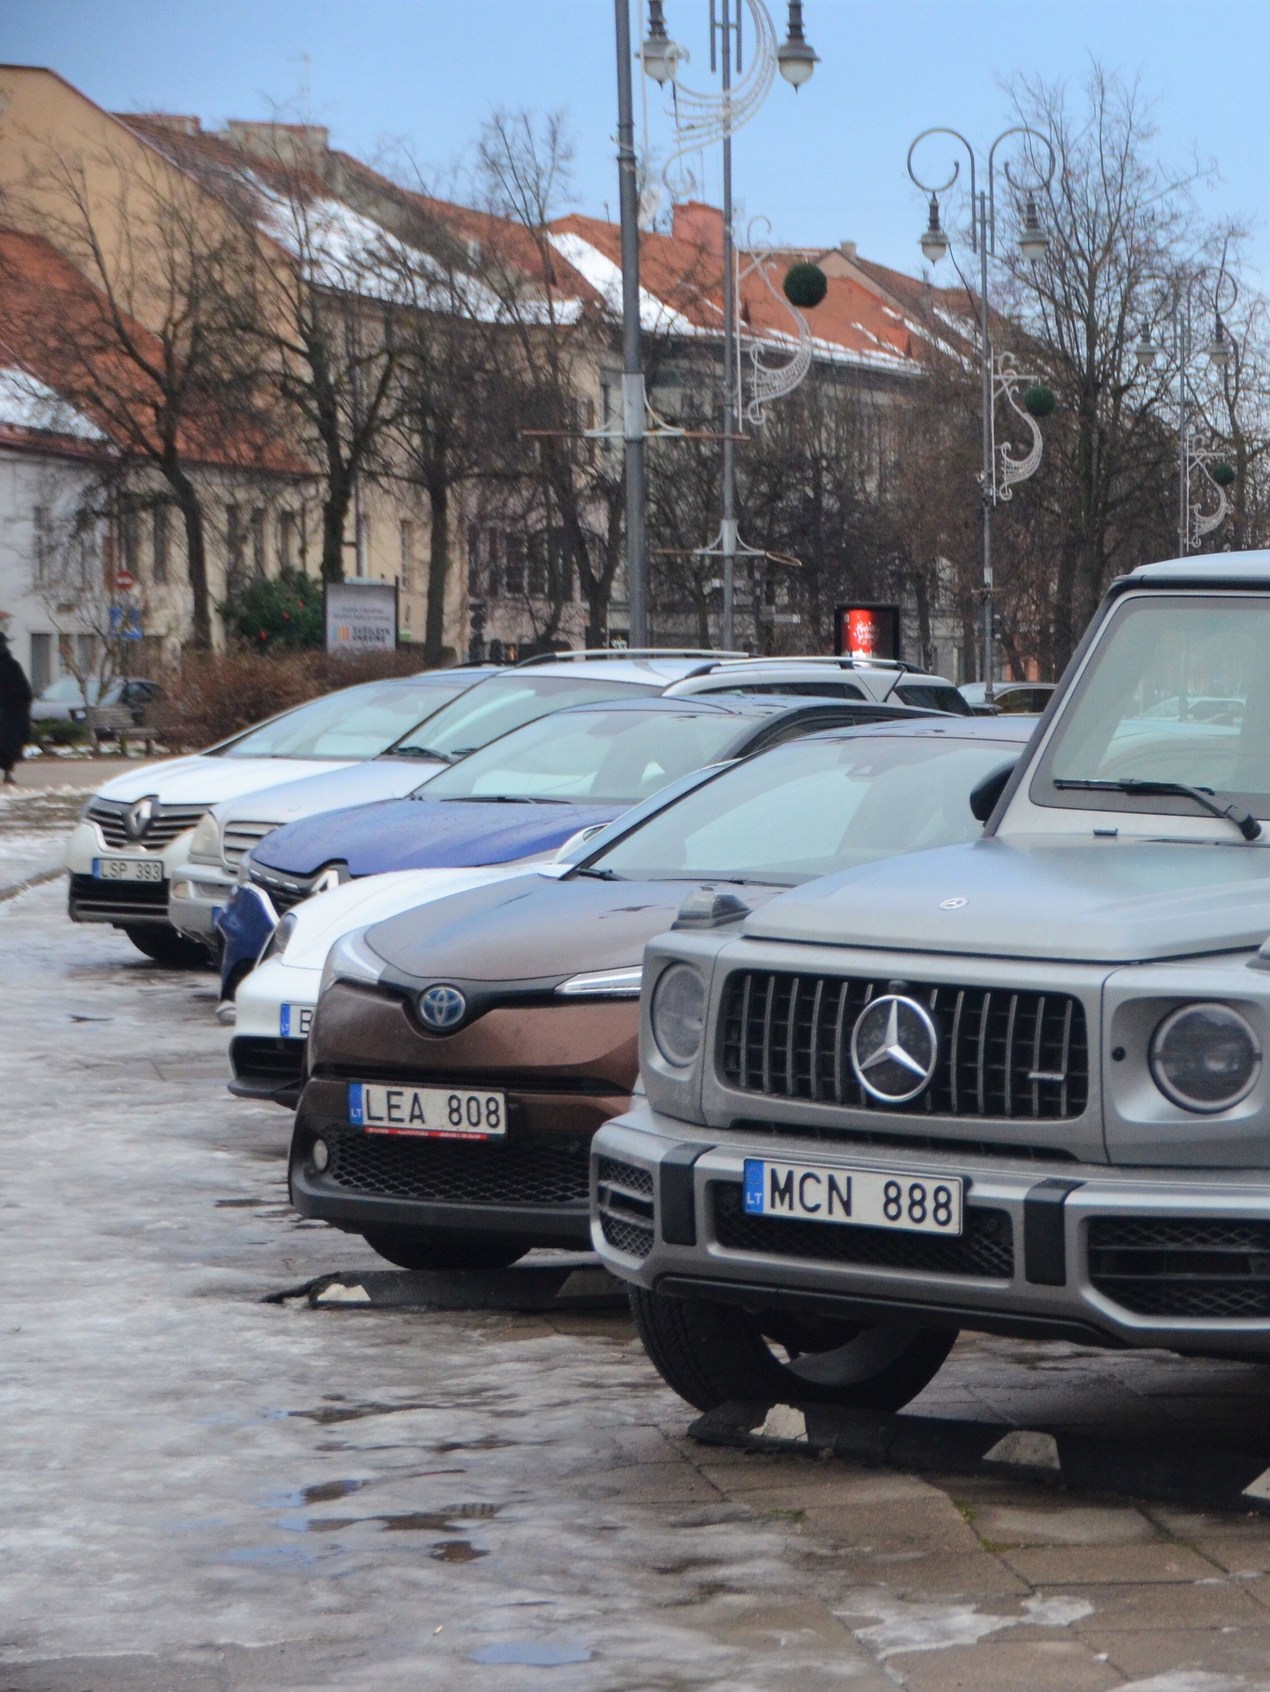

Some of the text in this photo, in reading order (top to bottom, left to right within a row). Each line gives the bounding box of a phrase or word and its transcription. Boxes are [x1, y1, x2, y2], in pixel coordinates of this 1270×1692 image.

[101, 862, 160, 880] LSP 393
[351, 1089, 500, 1129] LT LEA 808
[747, 1167, 952, 1226] LT MCN 888
